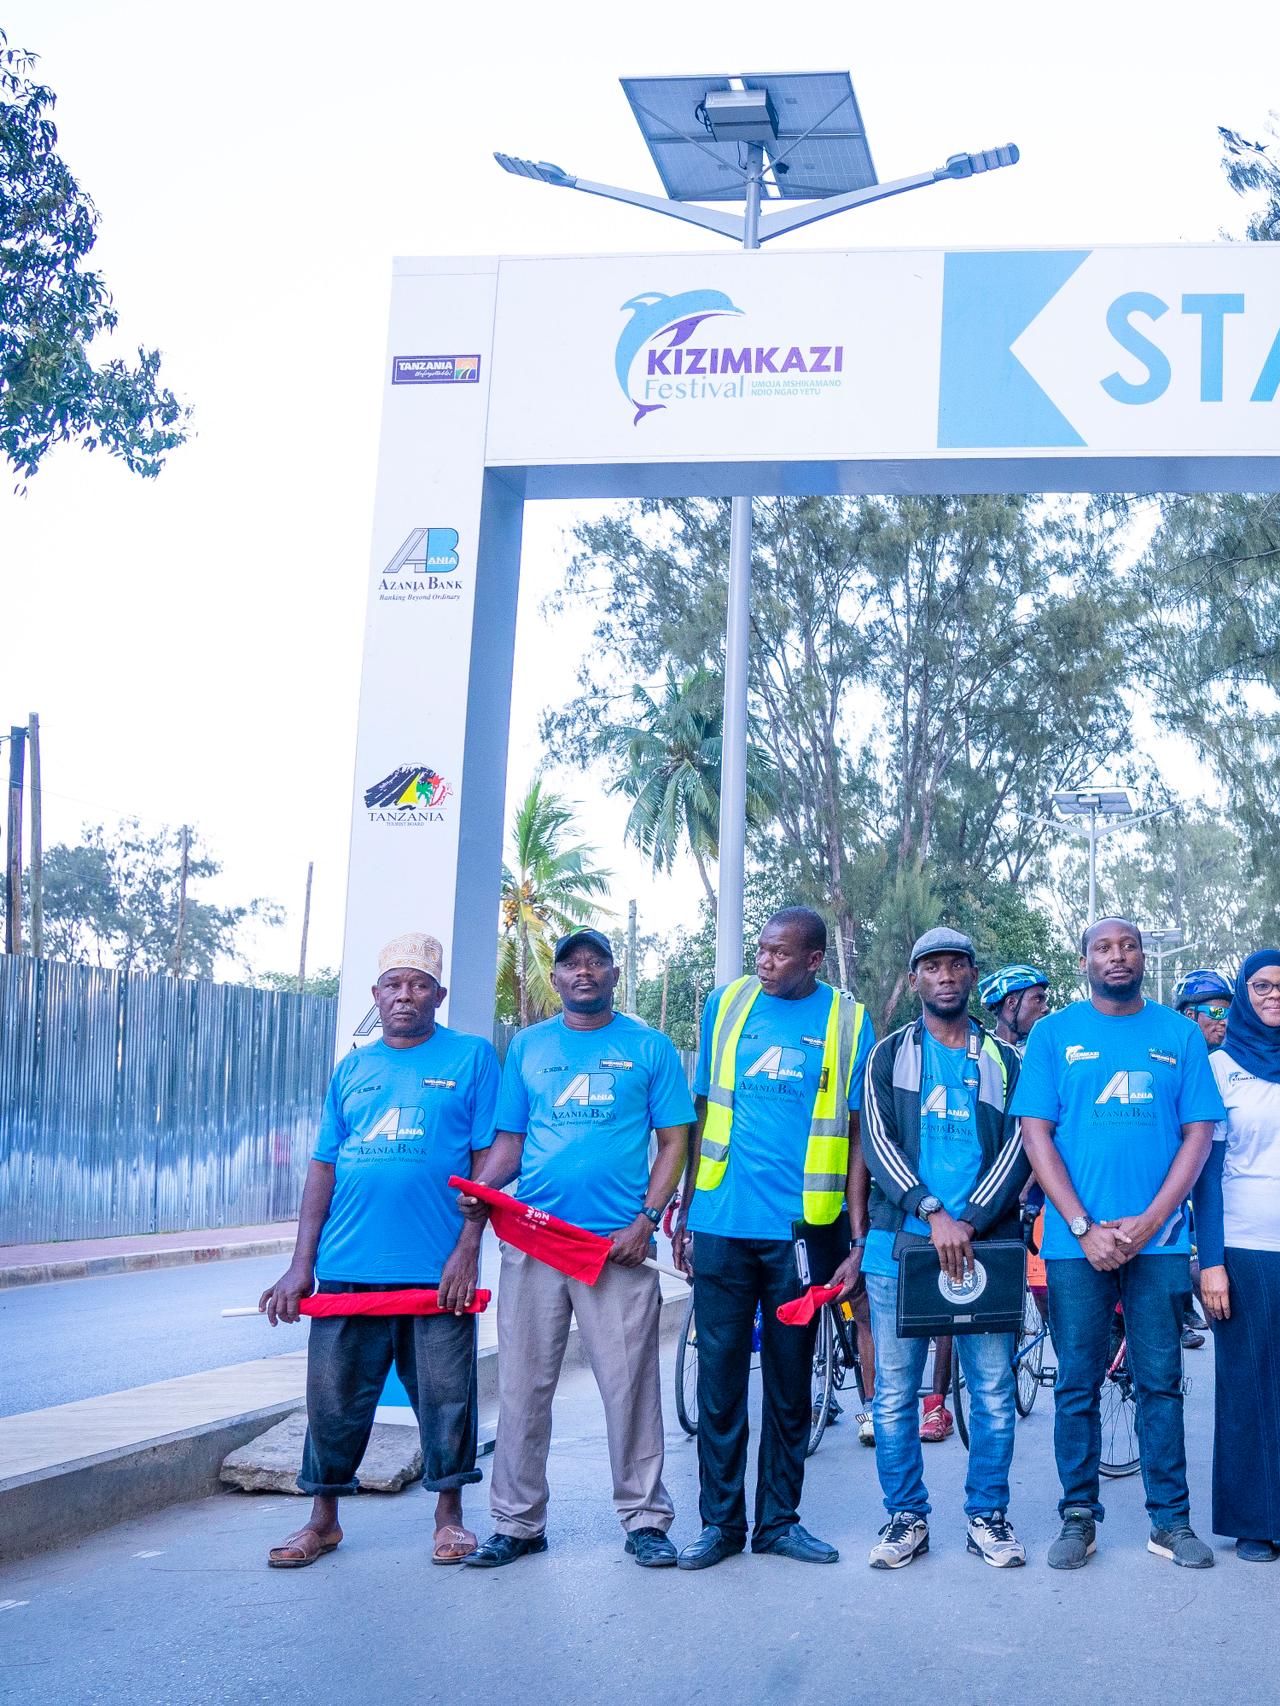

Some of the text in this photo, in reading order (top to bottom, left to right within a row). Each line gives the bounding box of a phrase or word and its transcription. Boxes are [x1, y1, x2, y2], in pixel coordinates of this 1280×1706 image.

[647, 345, 844, 376] KIZIMKAZI
[399, 361, 453, 371] TANZANIA
[645, 376, 745, 401] Festival
[751, 379, 842, 388] UMOJA MSHIKAMANO
[751, 388, 773, 396] NDIO
[774, 388, 798, 396] NGAO
[427, 556, 457, 565] ANIA
[428, 576, 463, 590] BANK
[367, 812, 444, 822] TANZANIA
